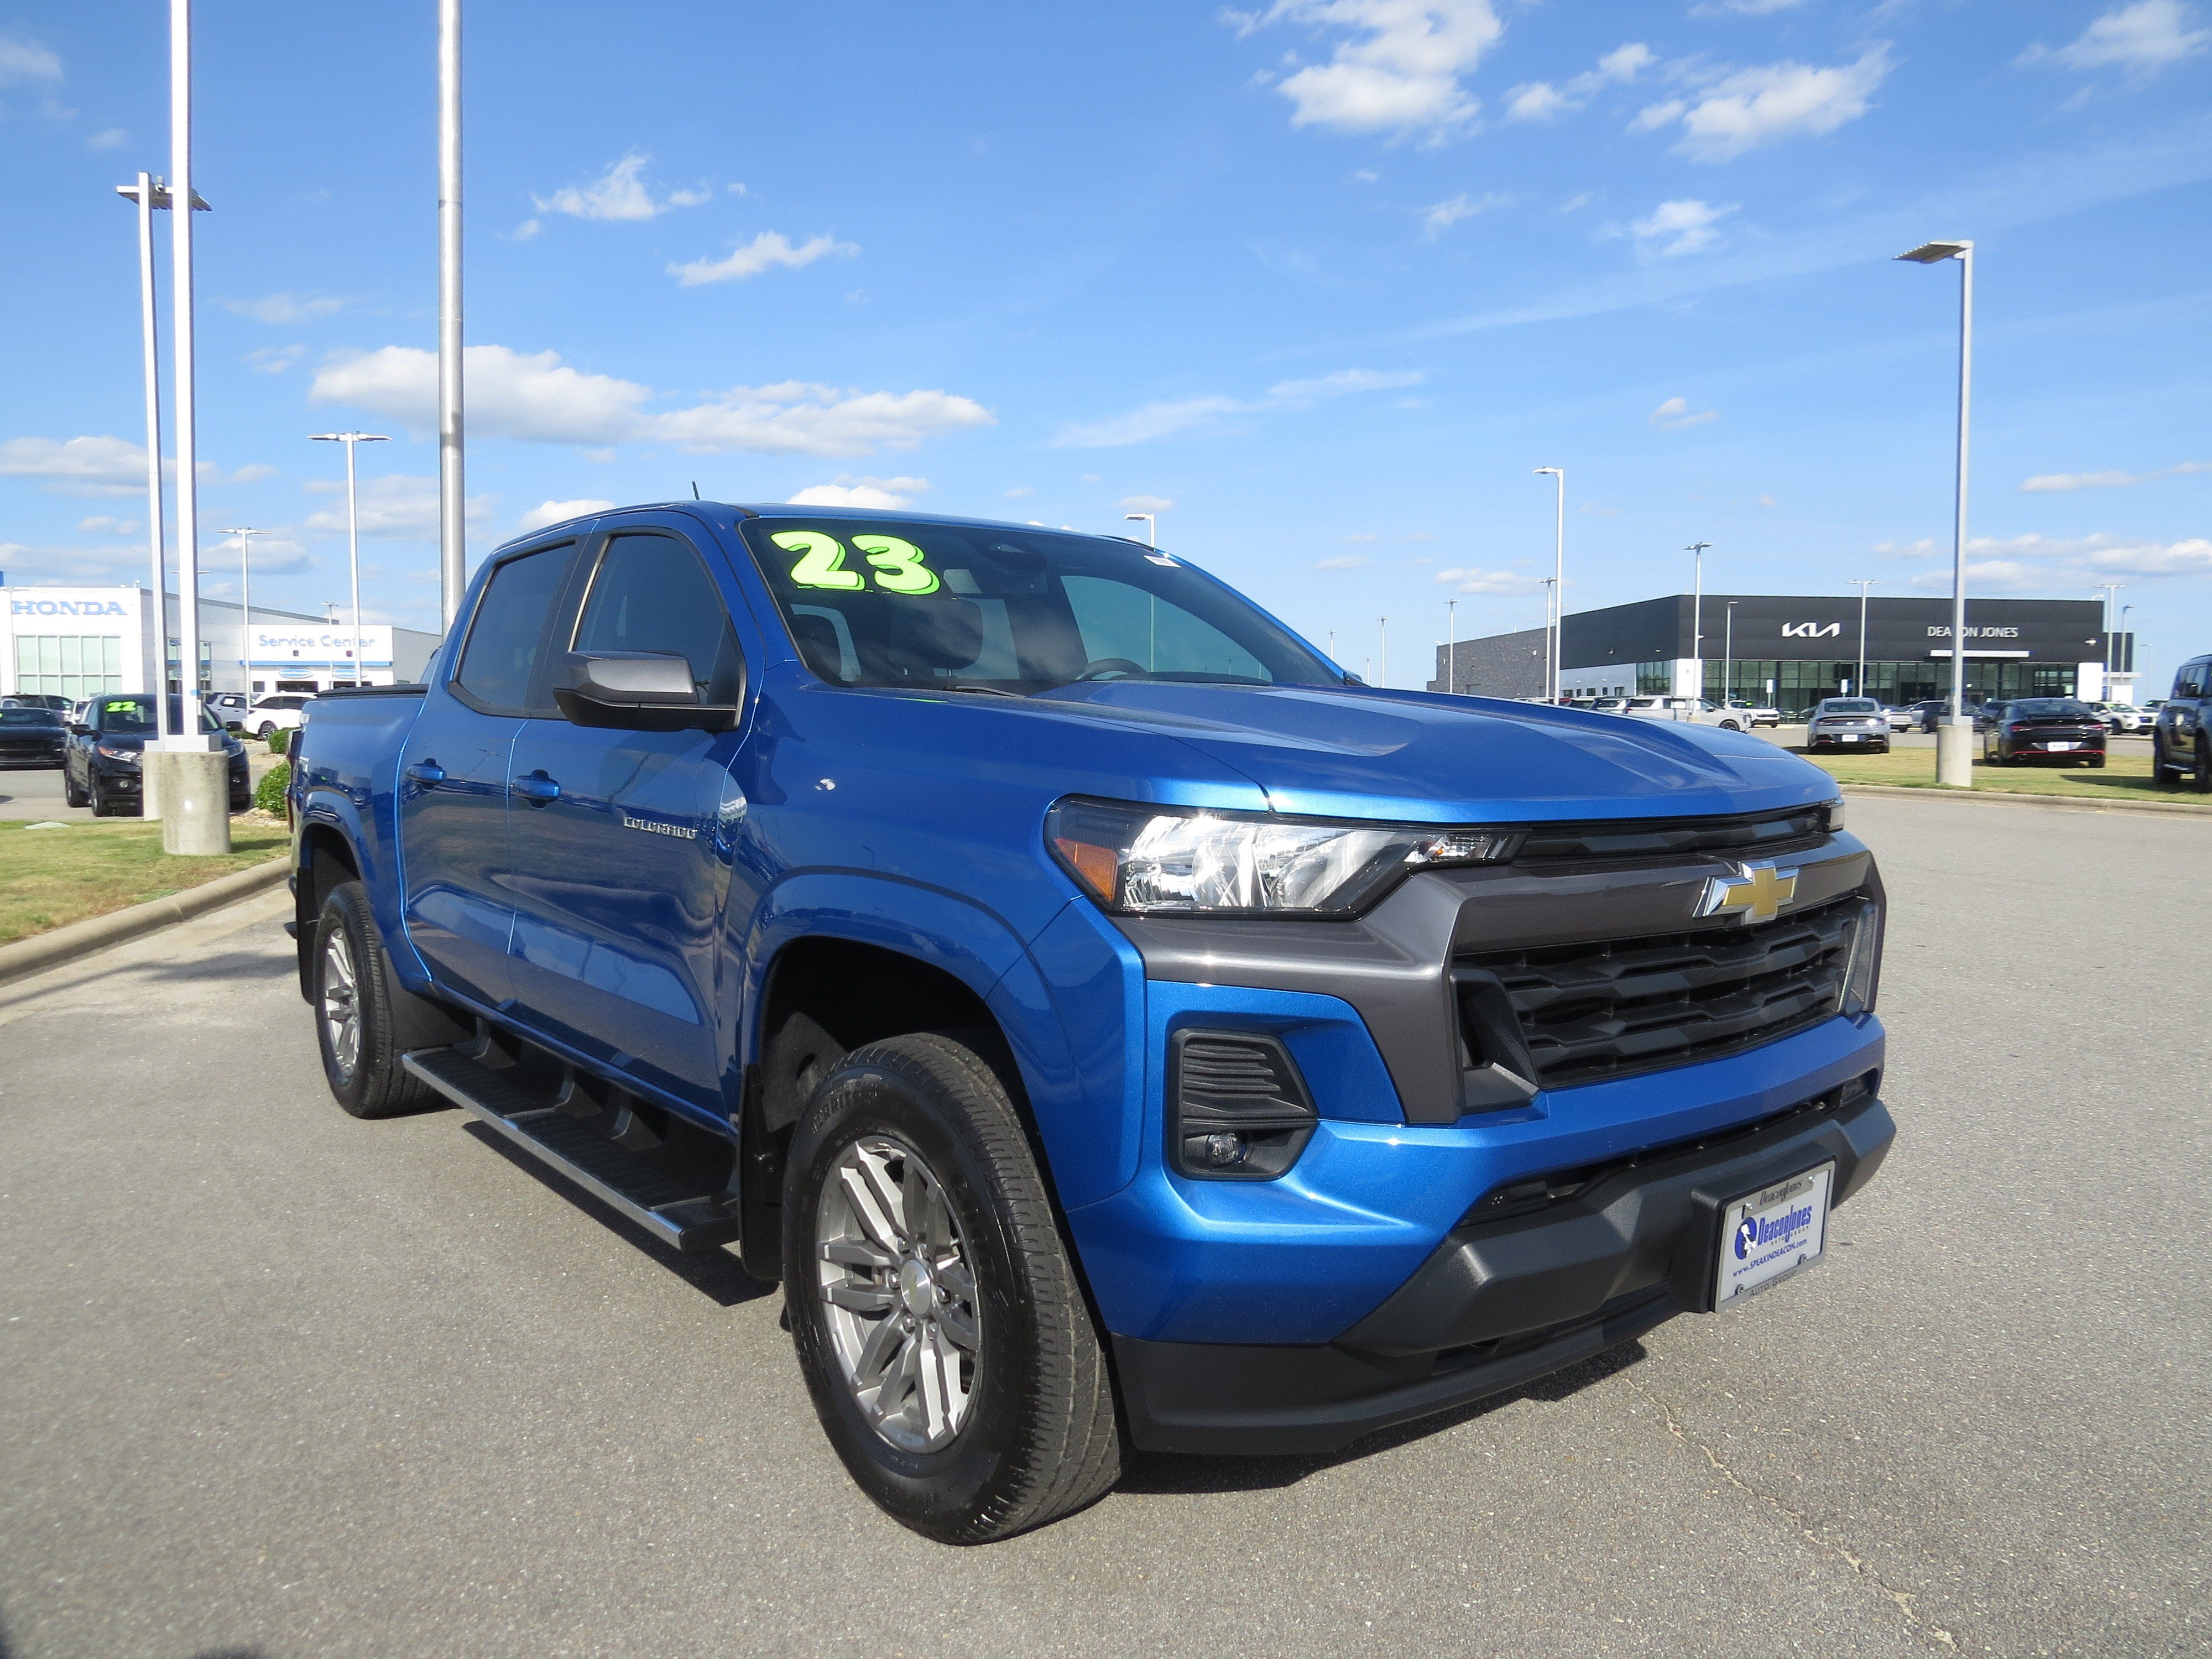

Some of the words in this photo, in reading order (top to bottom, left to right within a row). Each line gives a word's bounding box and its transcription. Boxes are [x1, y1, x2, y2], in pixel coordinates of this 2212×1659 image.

[770, 530, 941, 596] 23
[11, 601, 128, 615] HONDA
[1781, 622, 1841, 638] KIA
[1927, 626, 1978, 638] DEAON
[1980, 627, 2019, 638] JONES
[259, 634, 315, 646] Service
[320, 635, 375, 647] Cener
[107, 701, 137, 712] 22
[623, 816, 698, 840] COLORADO
[1771, 1235, 1785, 1245] AUTO
[1790, 1225, 1809, 1237] GROUP
[1732, 1239, 1808, 1277] www.SPEAKINDEACON.com
[1750, 1282, 1770, 1297] AUTO
[1772, 1269, 1797, 1287] GROUP
